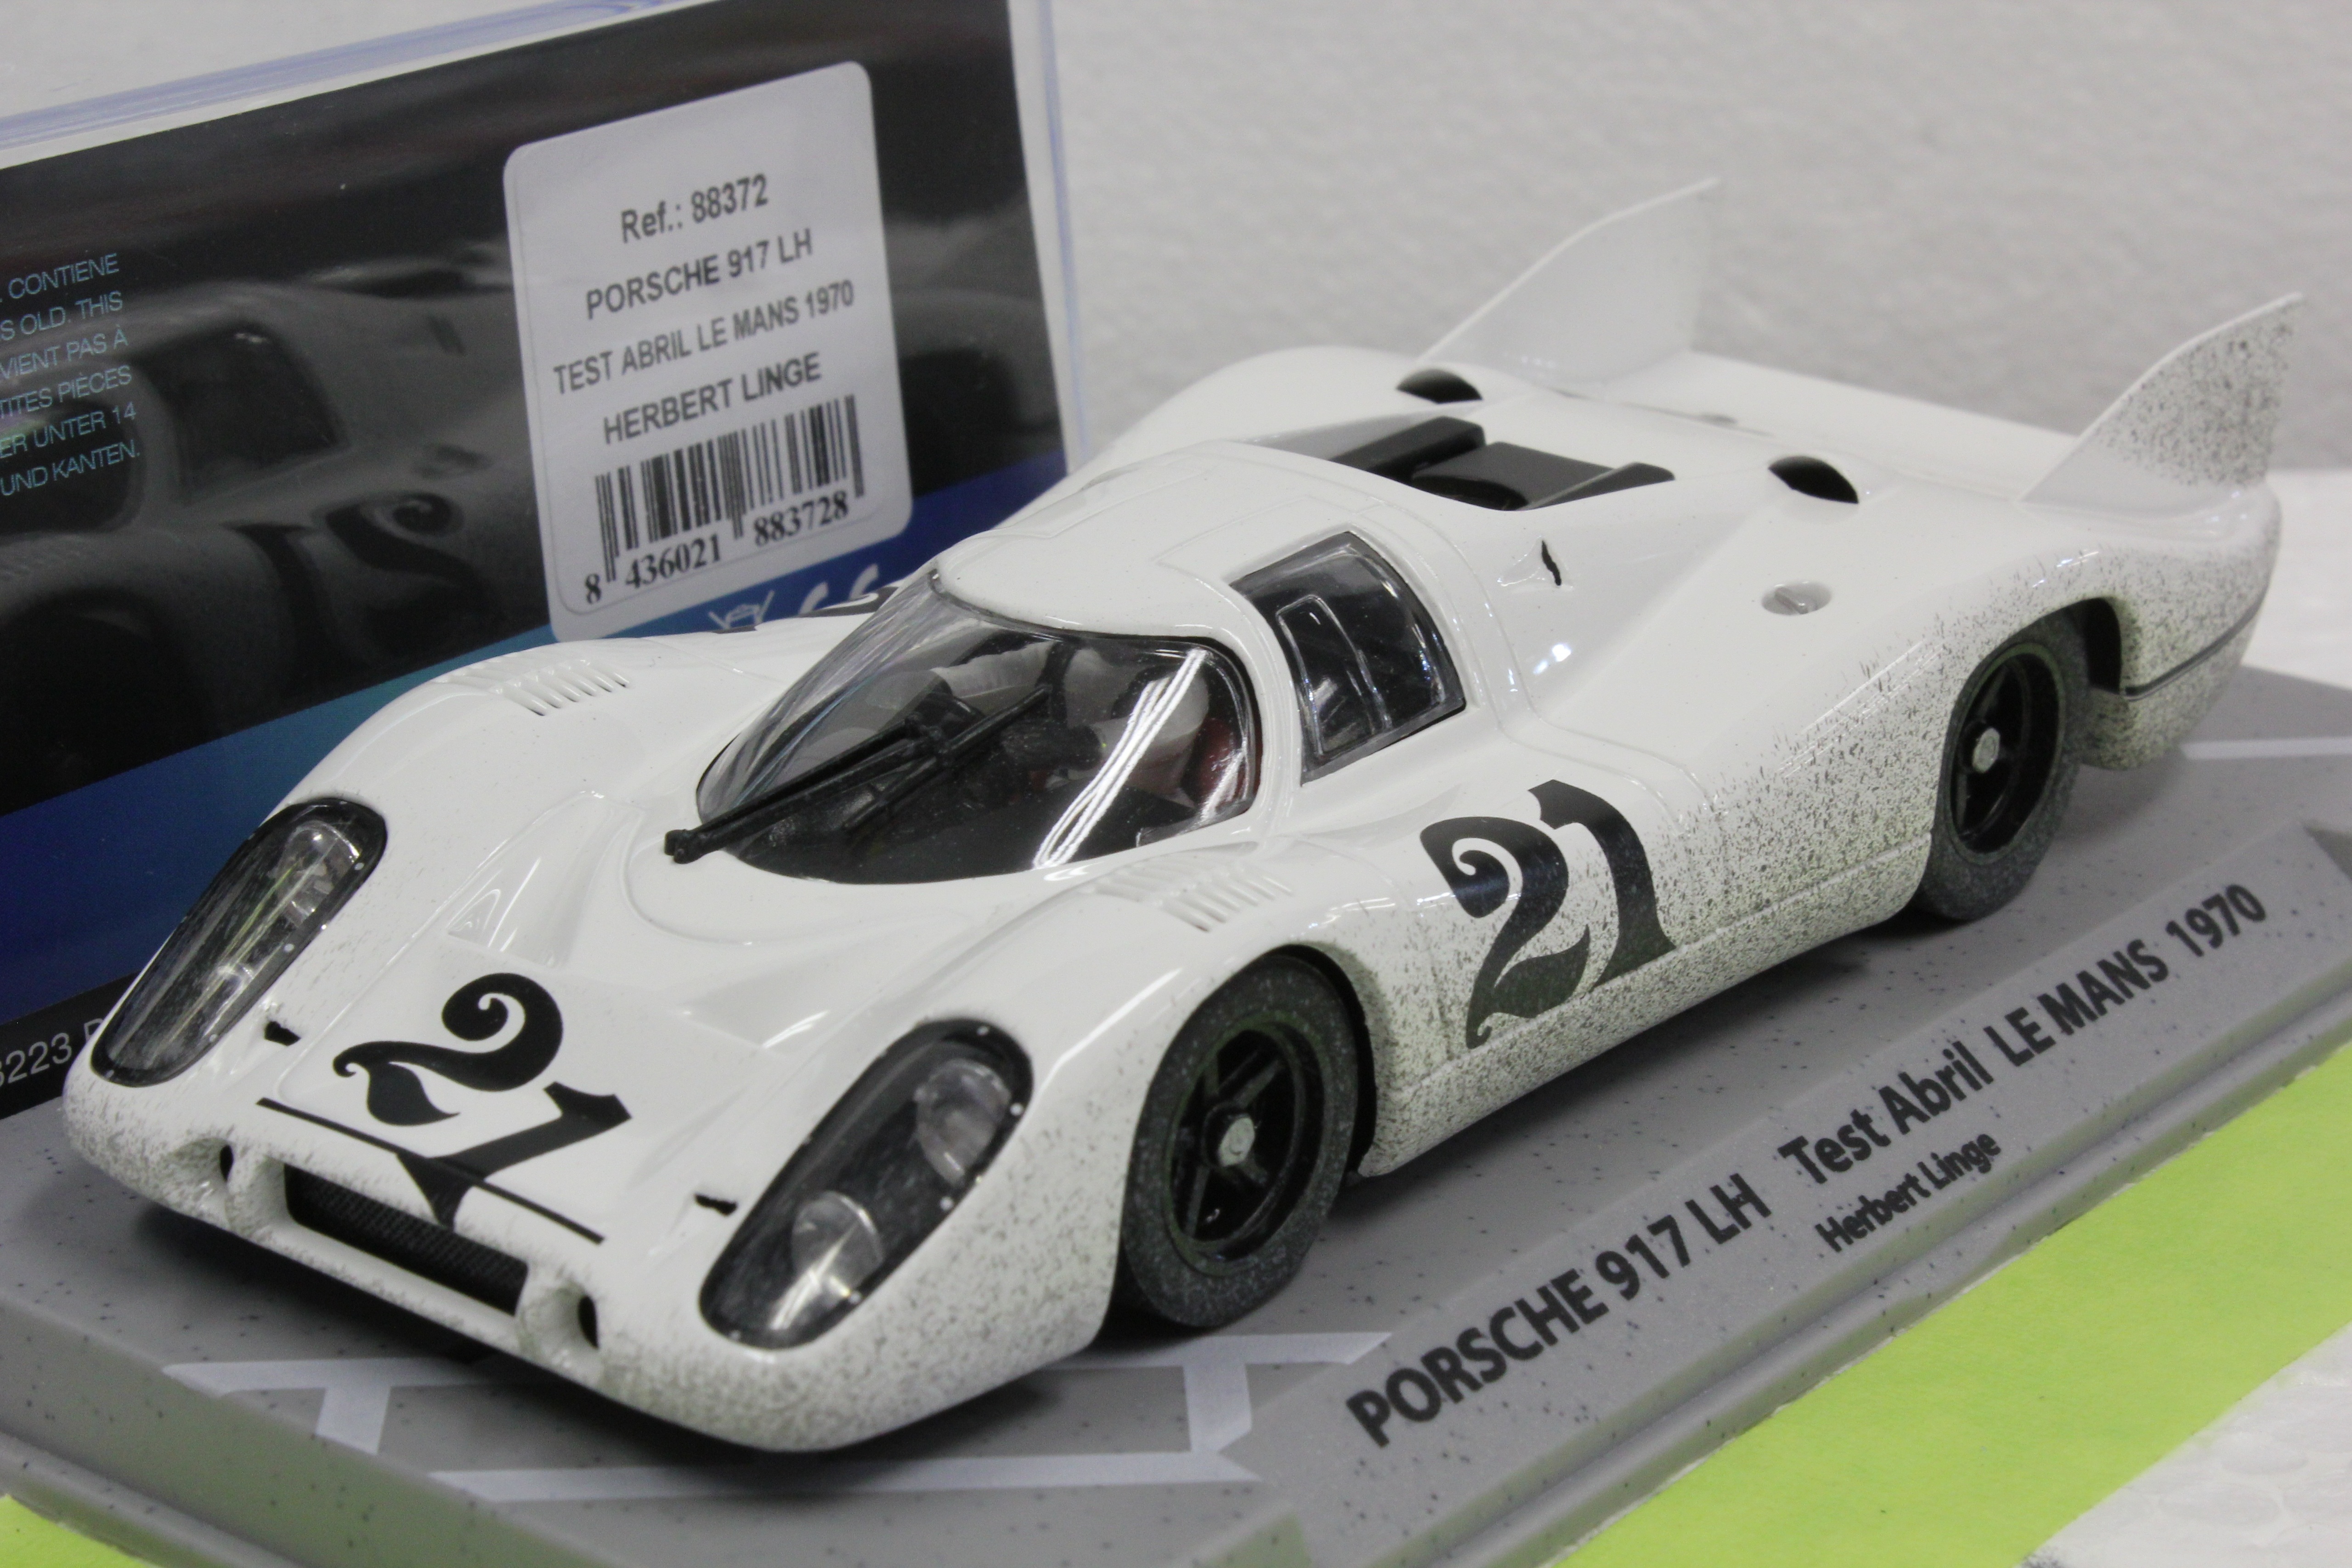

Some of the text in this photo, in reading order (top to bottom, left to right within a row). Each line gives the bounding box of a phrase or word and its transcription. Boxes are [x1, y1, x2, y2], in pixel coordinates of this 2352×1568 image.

[621, 173, 769, 243] Ref.: 88372
[8, 252, 120, 299] CONTIENE
[74, 290, 123, 319] THIS
[586, 228, 813, 320] PORSCHE 917 LH
[66, 333, 108, 362] PAS
[553, 279, 854, 394] TEST ABRIL LE MANS 1970
[33, 410, 107, 448] UNTER
[602, 352, 822, 445] HERBERT LINGE
[0, 439, 140, 496] UND KANTEN.
[584, 490, 849, 605] 8 436021 883728
[1419, 779, 1676, 1049] 21
[0, 1032, 72, 1087] 223
[332, 972, 632, 1230] 21
[1346, 884, 2267, 1448] PORSCHE 917 LH Test Abril LE MANS 1970
[1814, 1130, 2001, 1253] Herbert Linge
